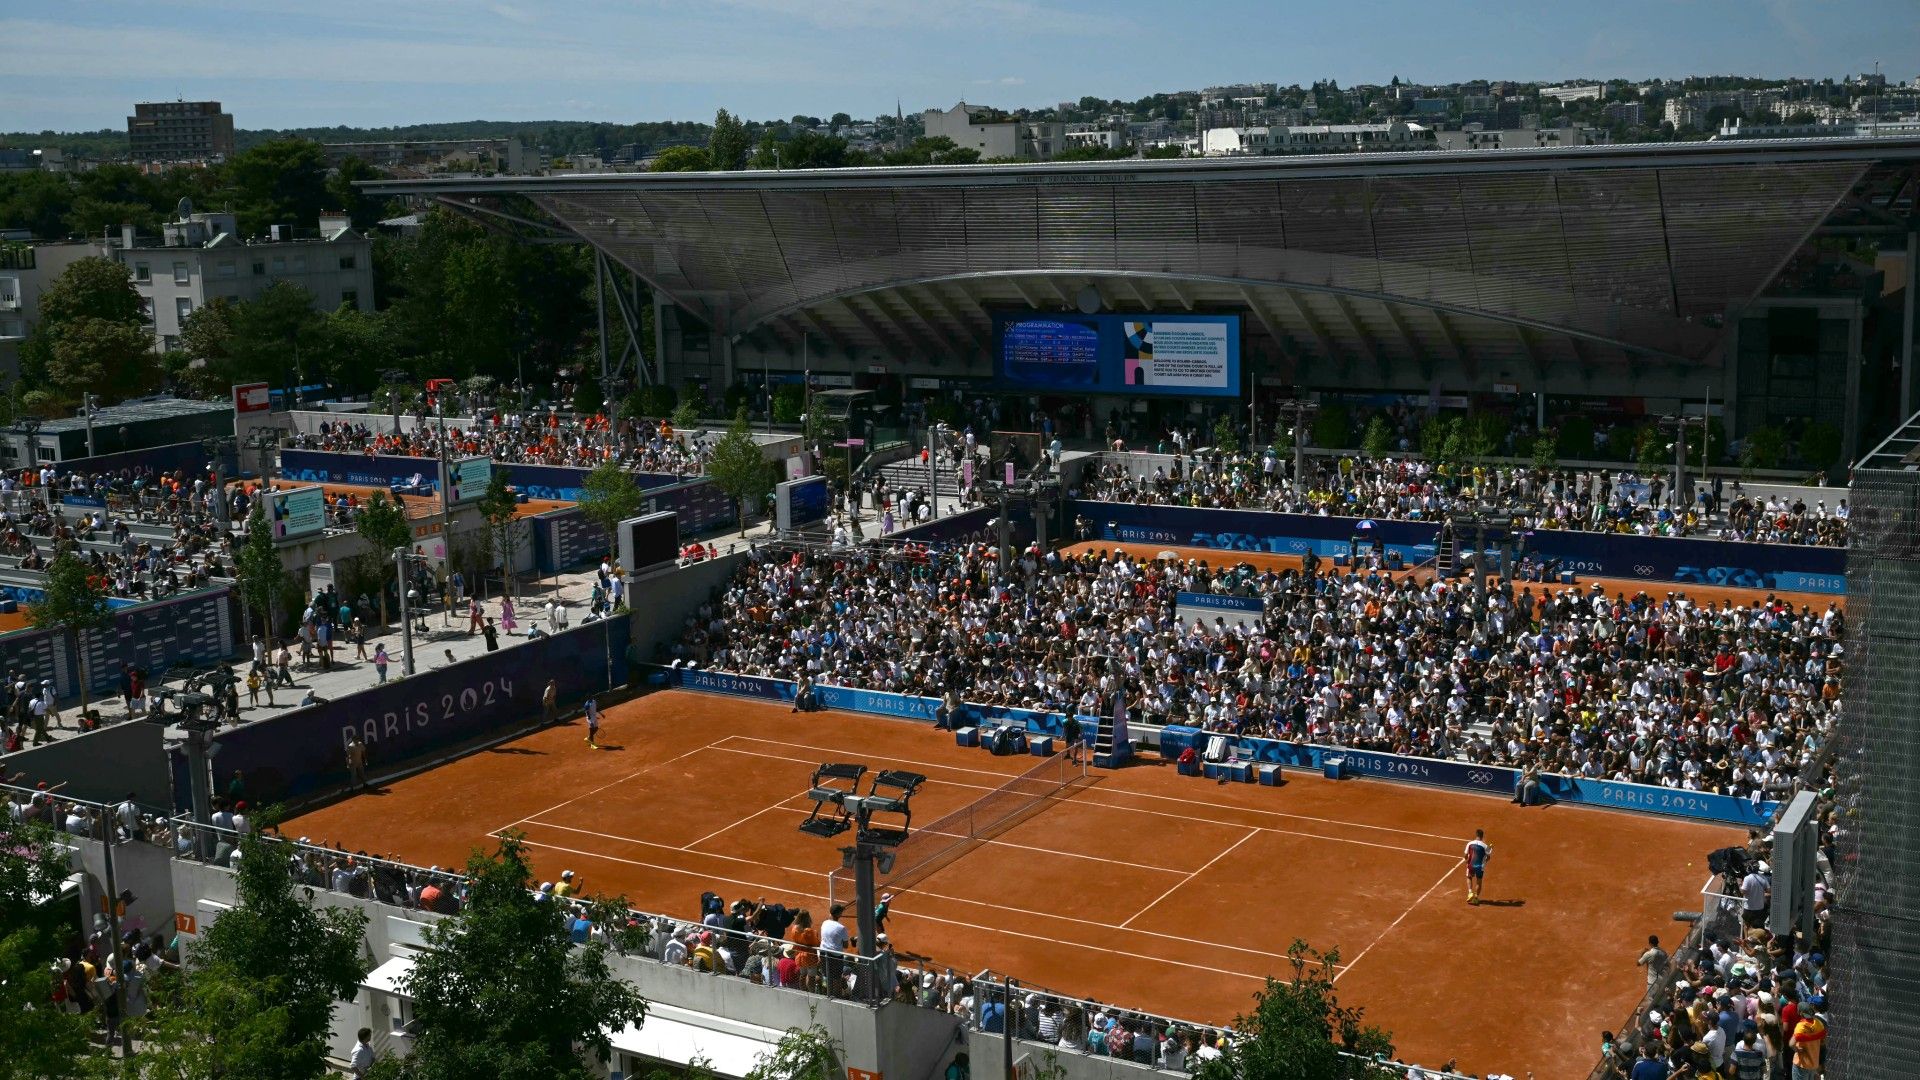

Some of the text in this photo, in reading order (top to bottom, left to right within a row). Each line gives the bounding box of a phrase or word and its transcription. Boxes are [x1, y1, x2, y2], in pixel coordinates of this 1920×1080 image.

[1149, 531, 1177, 541] 2024
[1569, 561, 1603, 572] 2024
[731, 680, 762, 692] 2024
[441, 677, 513, 719] 2024
[1387, 761, 1430, 777] 2024
[1661, 795, 1708, 812] 2024
[183, 917, 191, 930] 7
